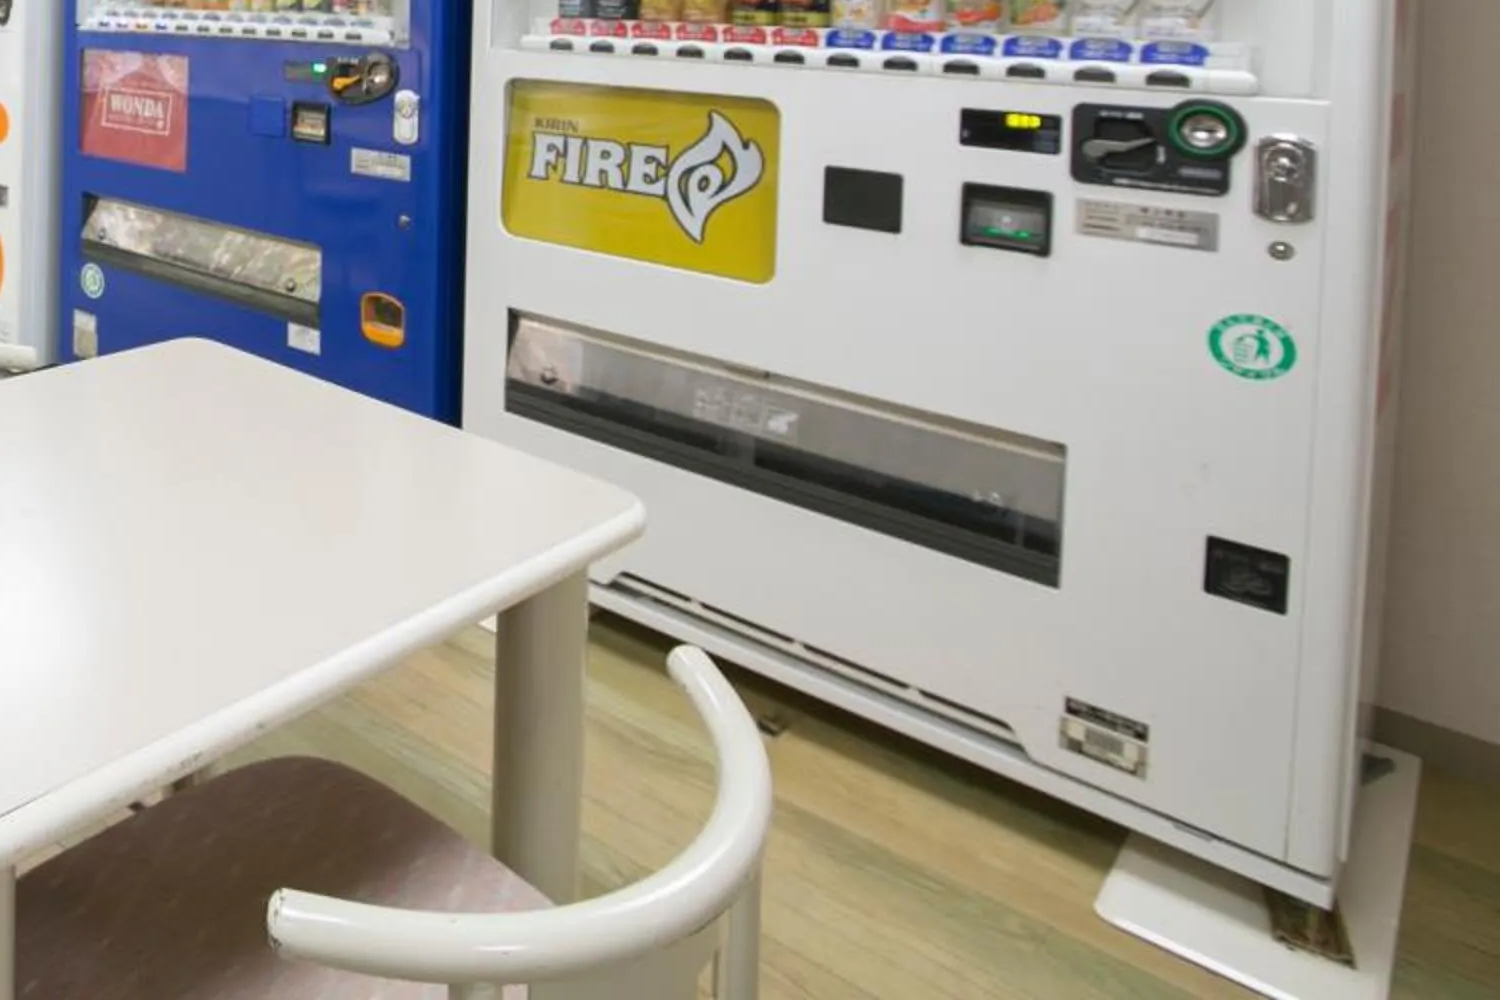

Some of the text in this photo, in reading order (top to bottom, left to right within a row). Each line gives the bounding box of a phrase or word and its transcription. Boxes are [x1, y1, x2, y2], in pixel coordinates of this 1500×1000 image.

[110, 93, 165, 119] WONDA
[534, 117, 579, 134] KIRIN
[527, 131, 670, 199] FIRE
